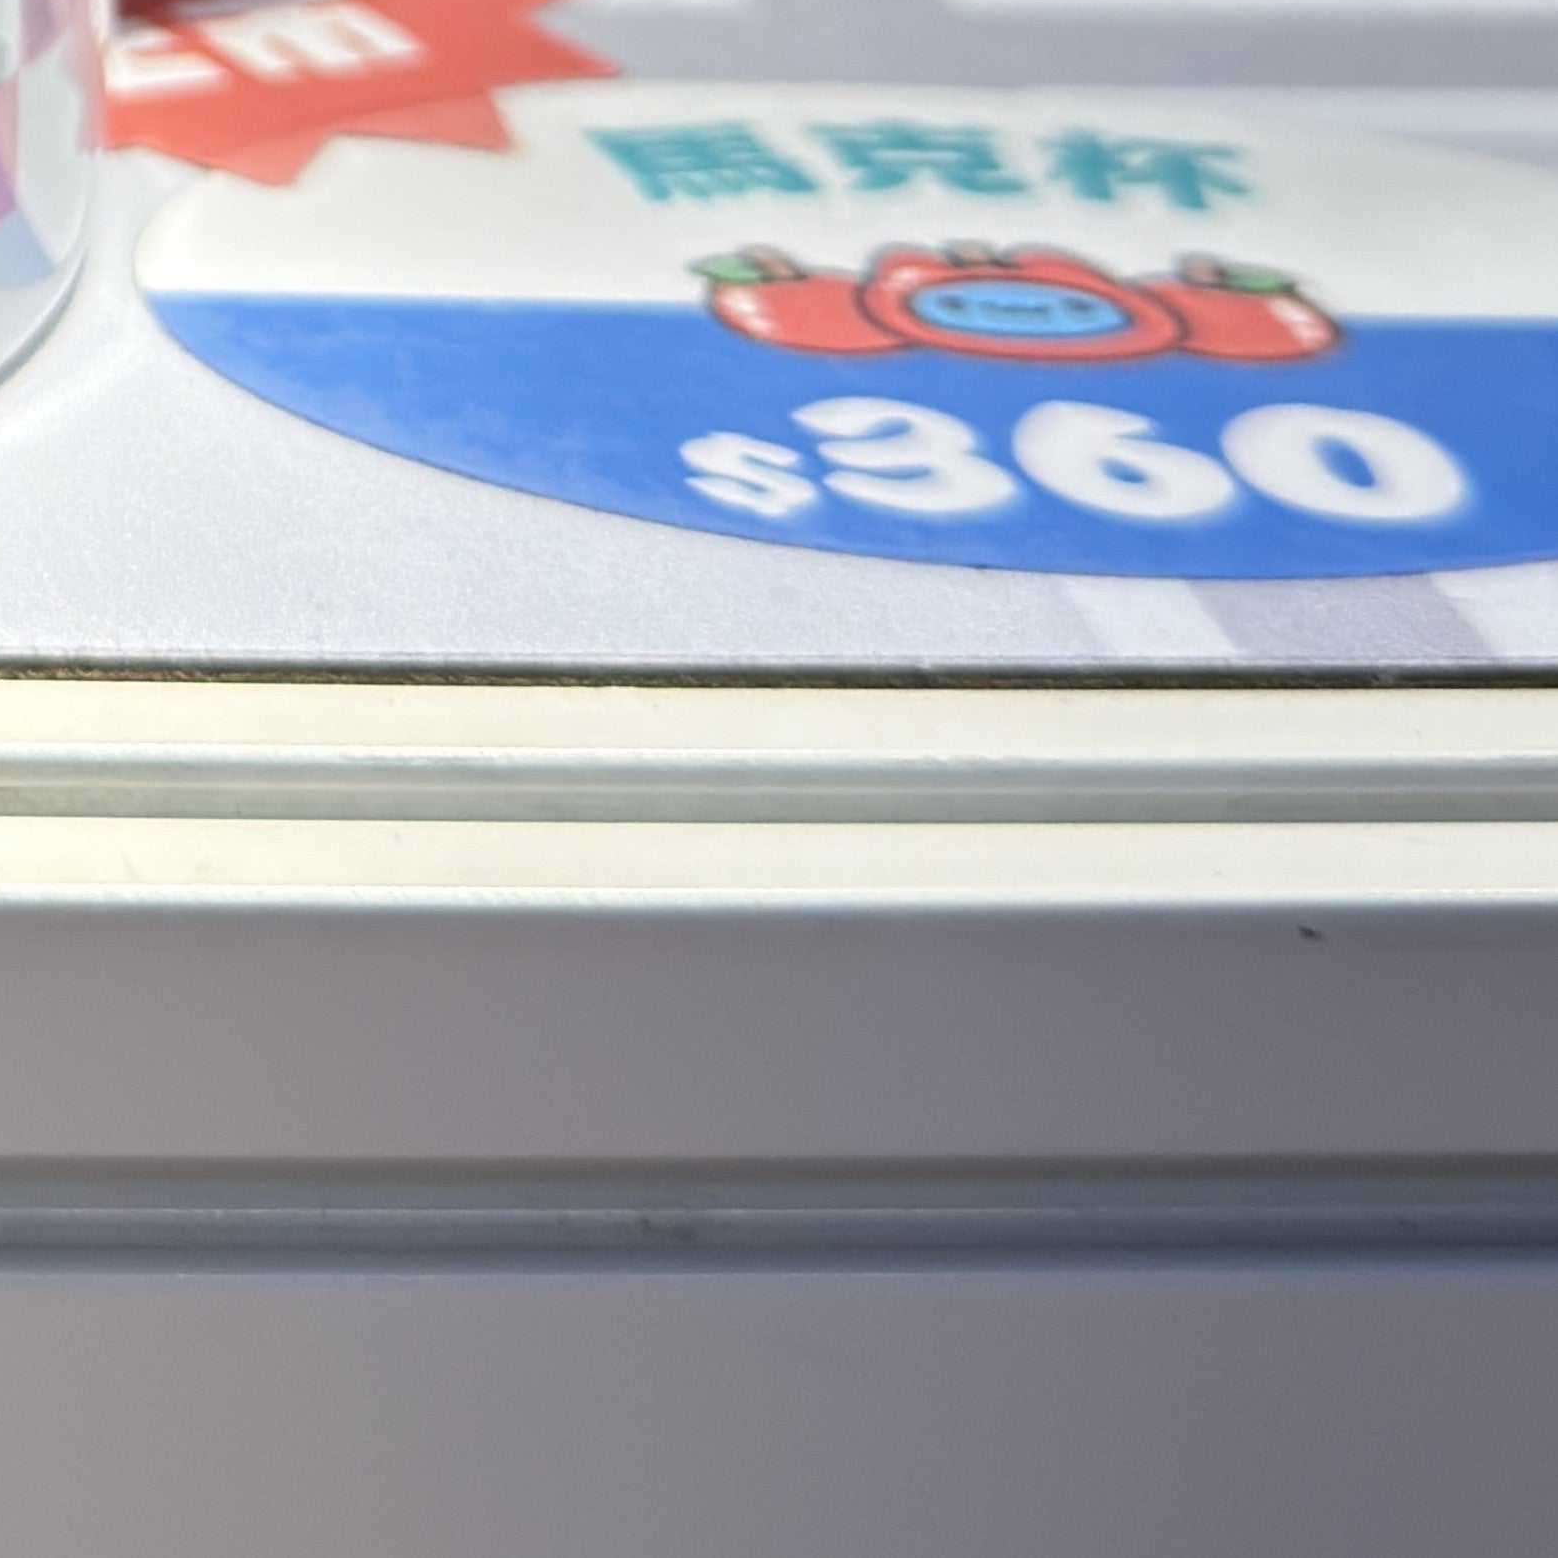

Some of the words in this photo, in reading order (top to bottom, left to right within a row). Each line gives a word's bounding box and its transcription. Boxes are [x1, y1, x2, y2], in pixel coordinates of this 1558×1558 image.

[583, 119, 1254, 213] 馬克杯
[679, 395, 1468, 523] $360
